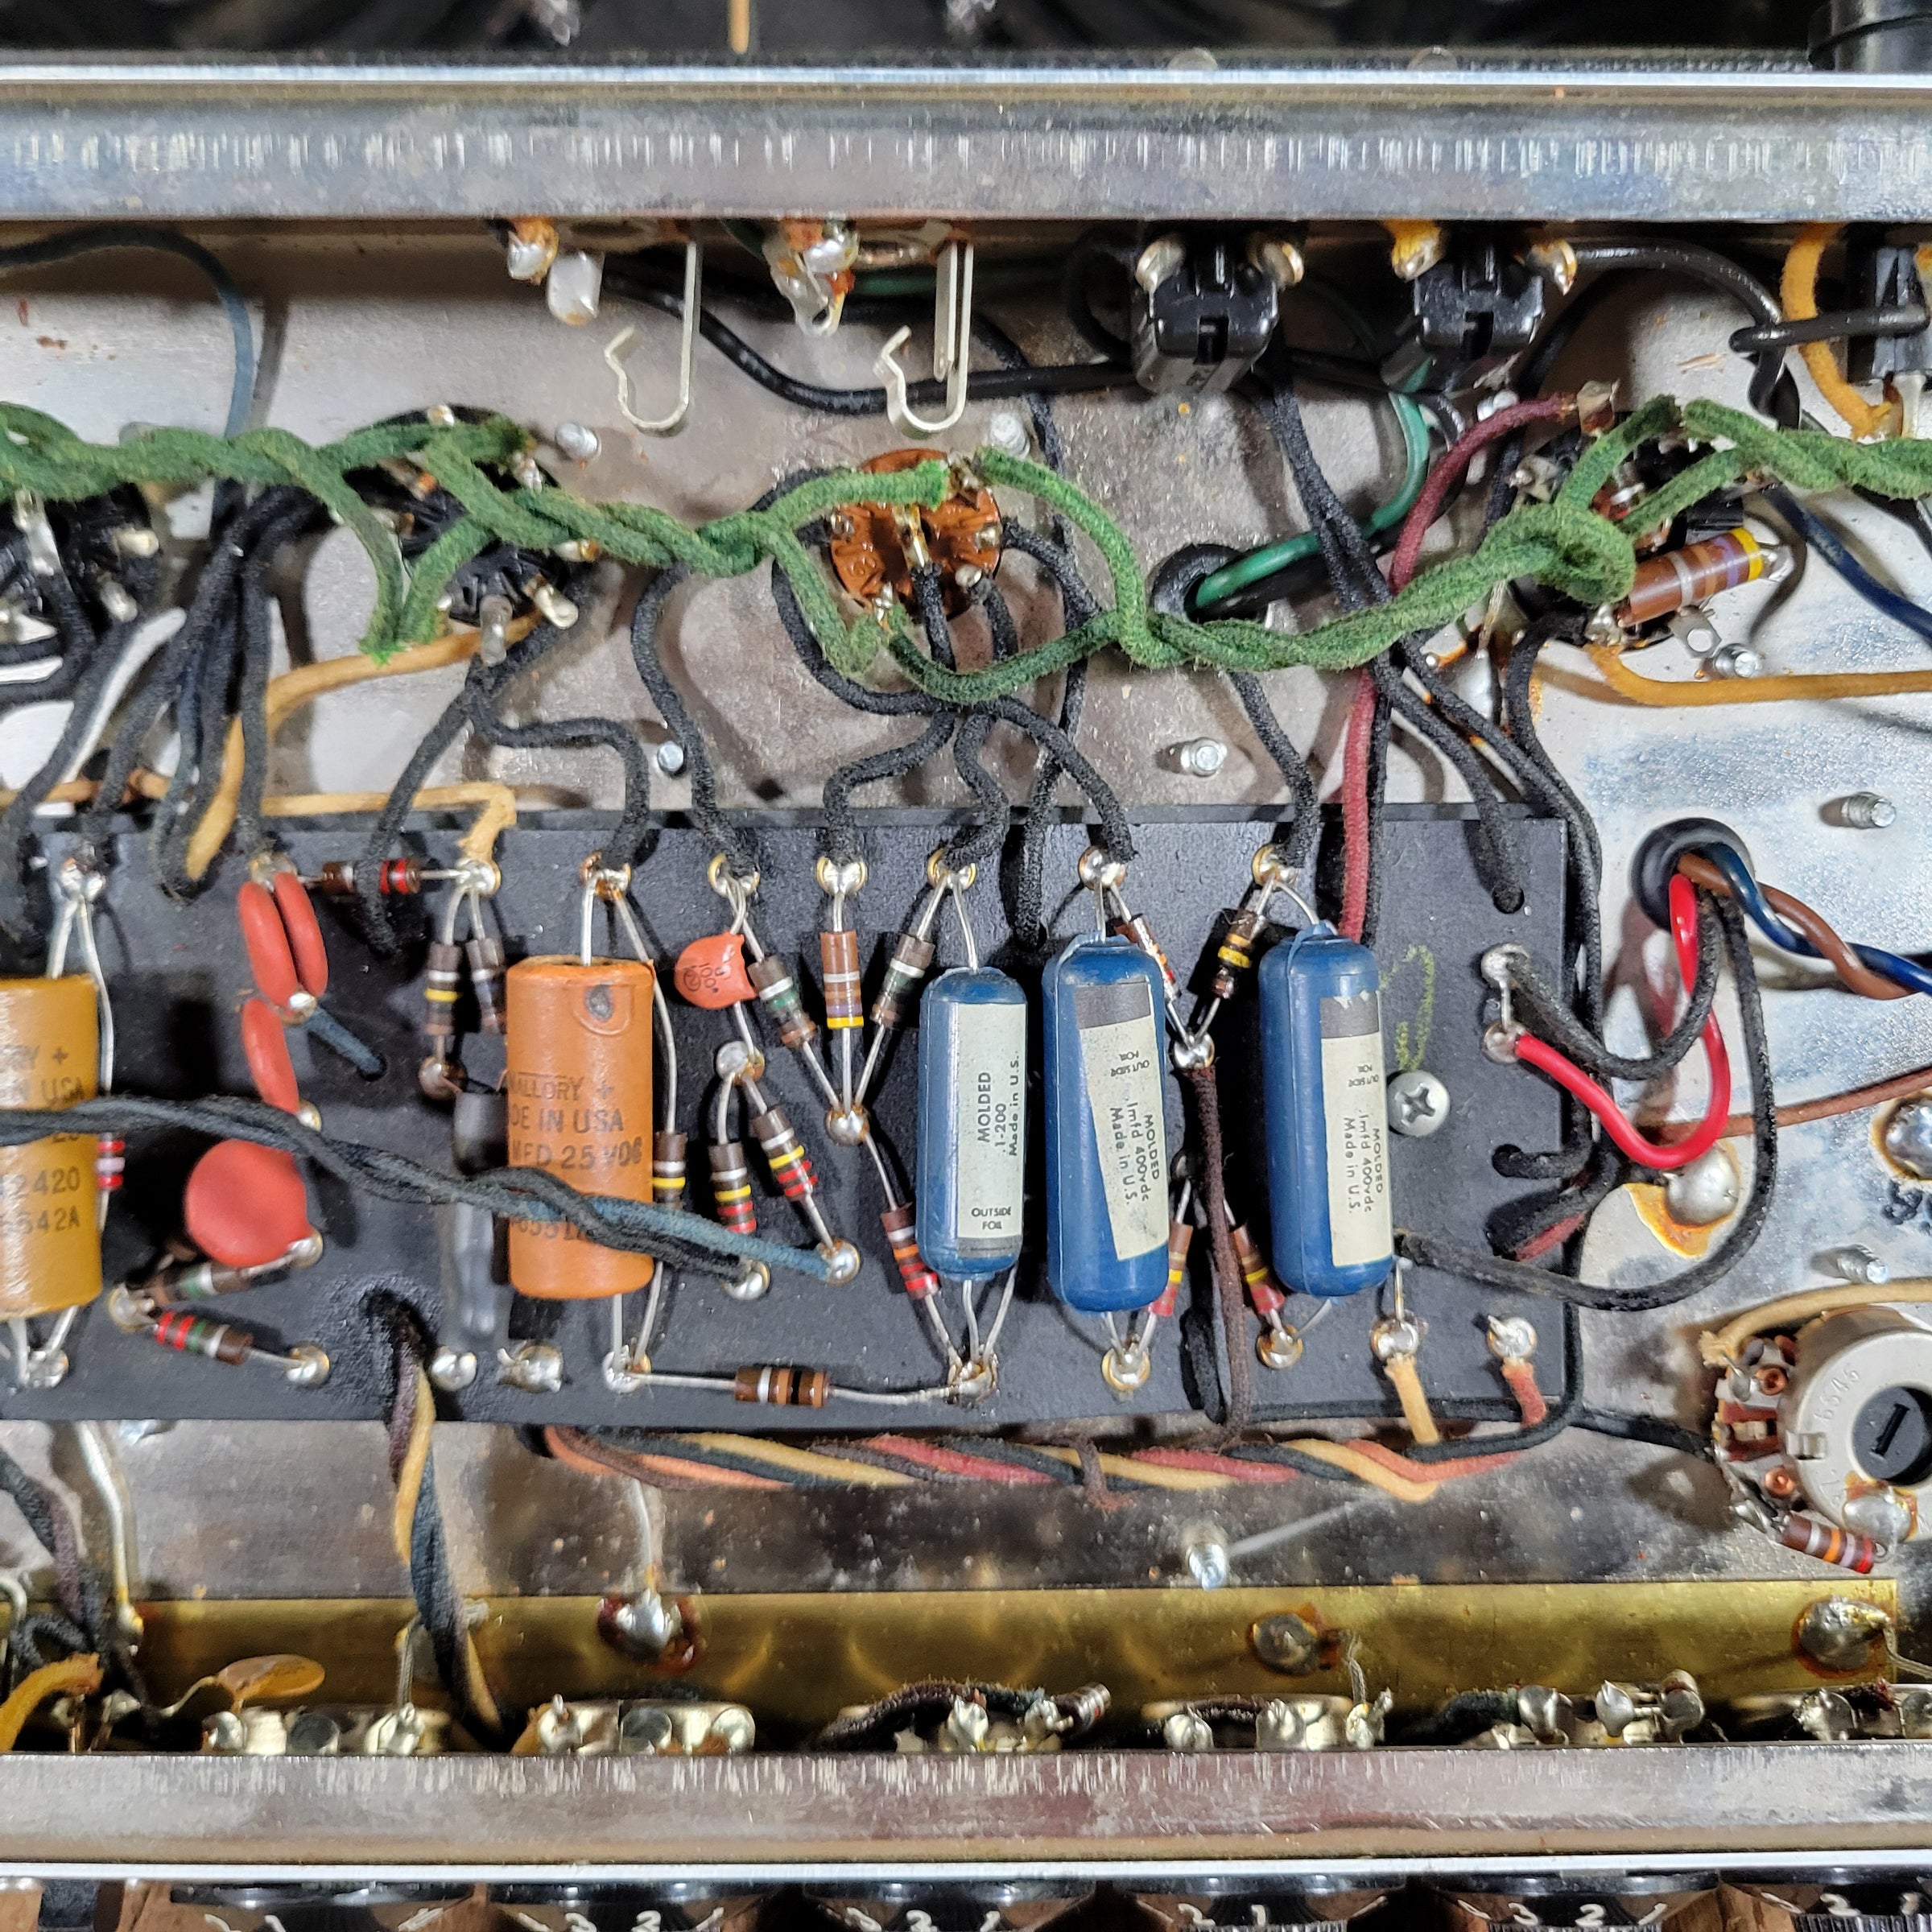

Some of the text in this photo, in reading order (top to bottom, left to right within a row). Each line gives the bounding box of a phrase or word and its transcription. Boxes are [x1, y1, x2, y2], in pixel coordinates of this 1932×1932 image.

[510, 1104, 625, 1134] DE IN USA
[977, 1071, 992, 1143] MOLDED
[1009, 1092, 1019, 1107] in
[562, 1144, 597, 1170] 25
[1008, 1113, 1018, 1156] Made
[1110, 1107, 1138, 1205] Made in U.S.
[1143, 1114, 1160, 1180] MOLDED
[1135, 1146, 1151, 1202] 400vdc
[1344, 1117, 1361, 1214] Made in U.S.
[1372, 1128, 1383, 1193] MOLDED
[971, 1206, 1012, 1217] OUTSIDE
[1508, 1902, 1539, 1926] 3
[1575, 1903, 1606, 1926] 2
